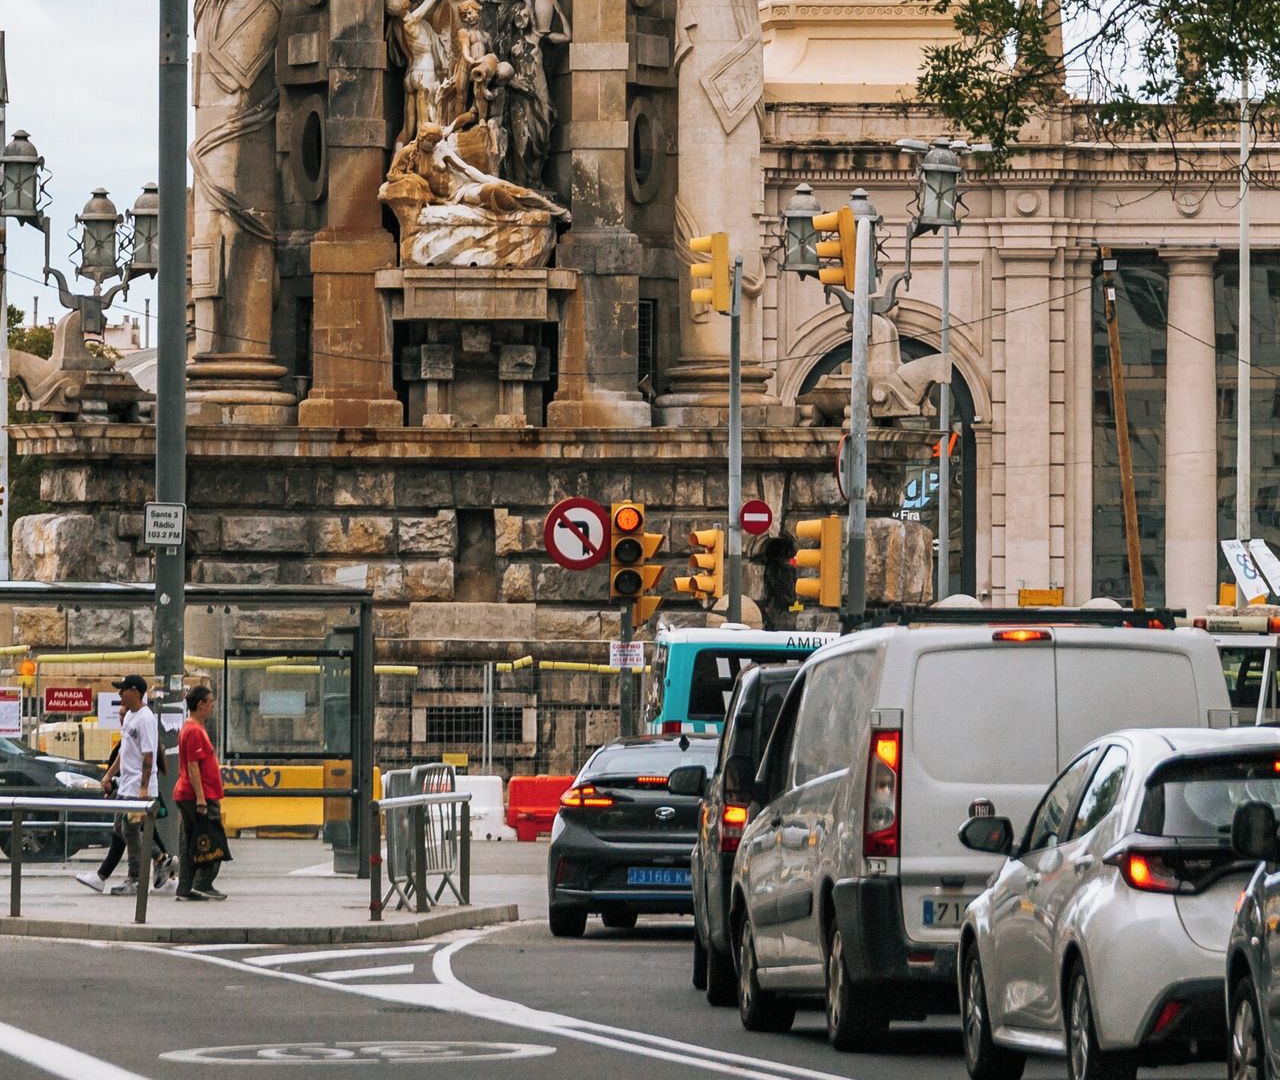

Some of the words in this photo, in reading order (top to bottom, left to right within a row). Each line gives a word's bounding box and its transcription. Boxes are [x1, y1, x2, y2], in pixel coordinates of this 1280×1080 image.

[151, 510, 172, 518] Sants
[900, 510, 920, 520] Fira
[54, 691, 84, 699] PARADA
